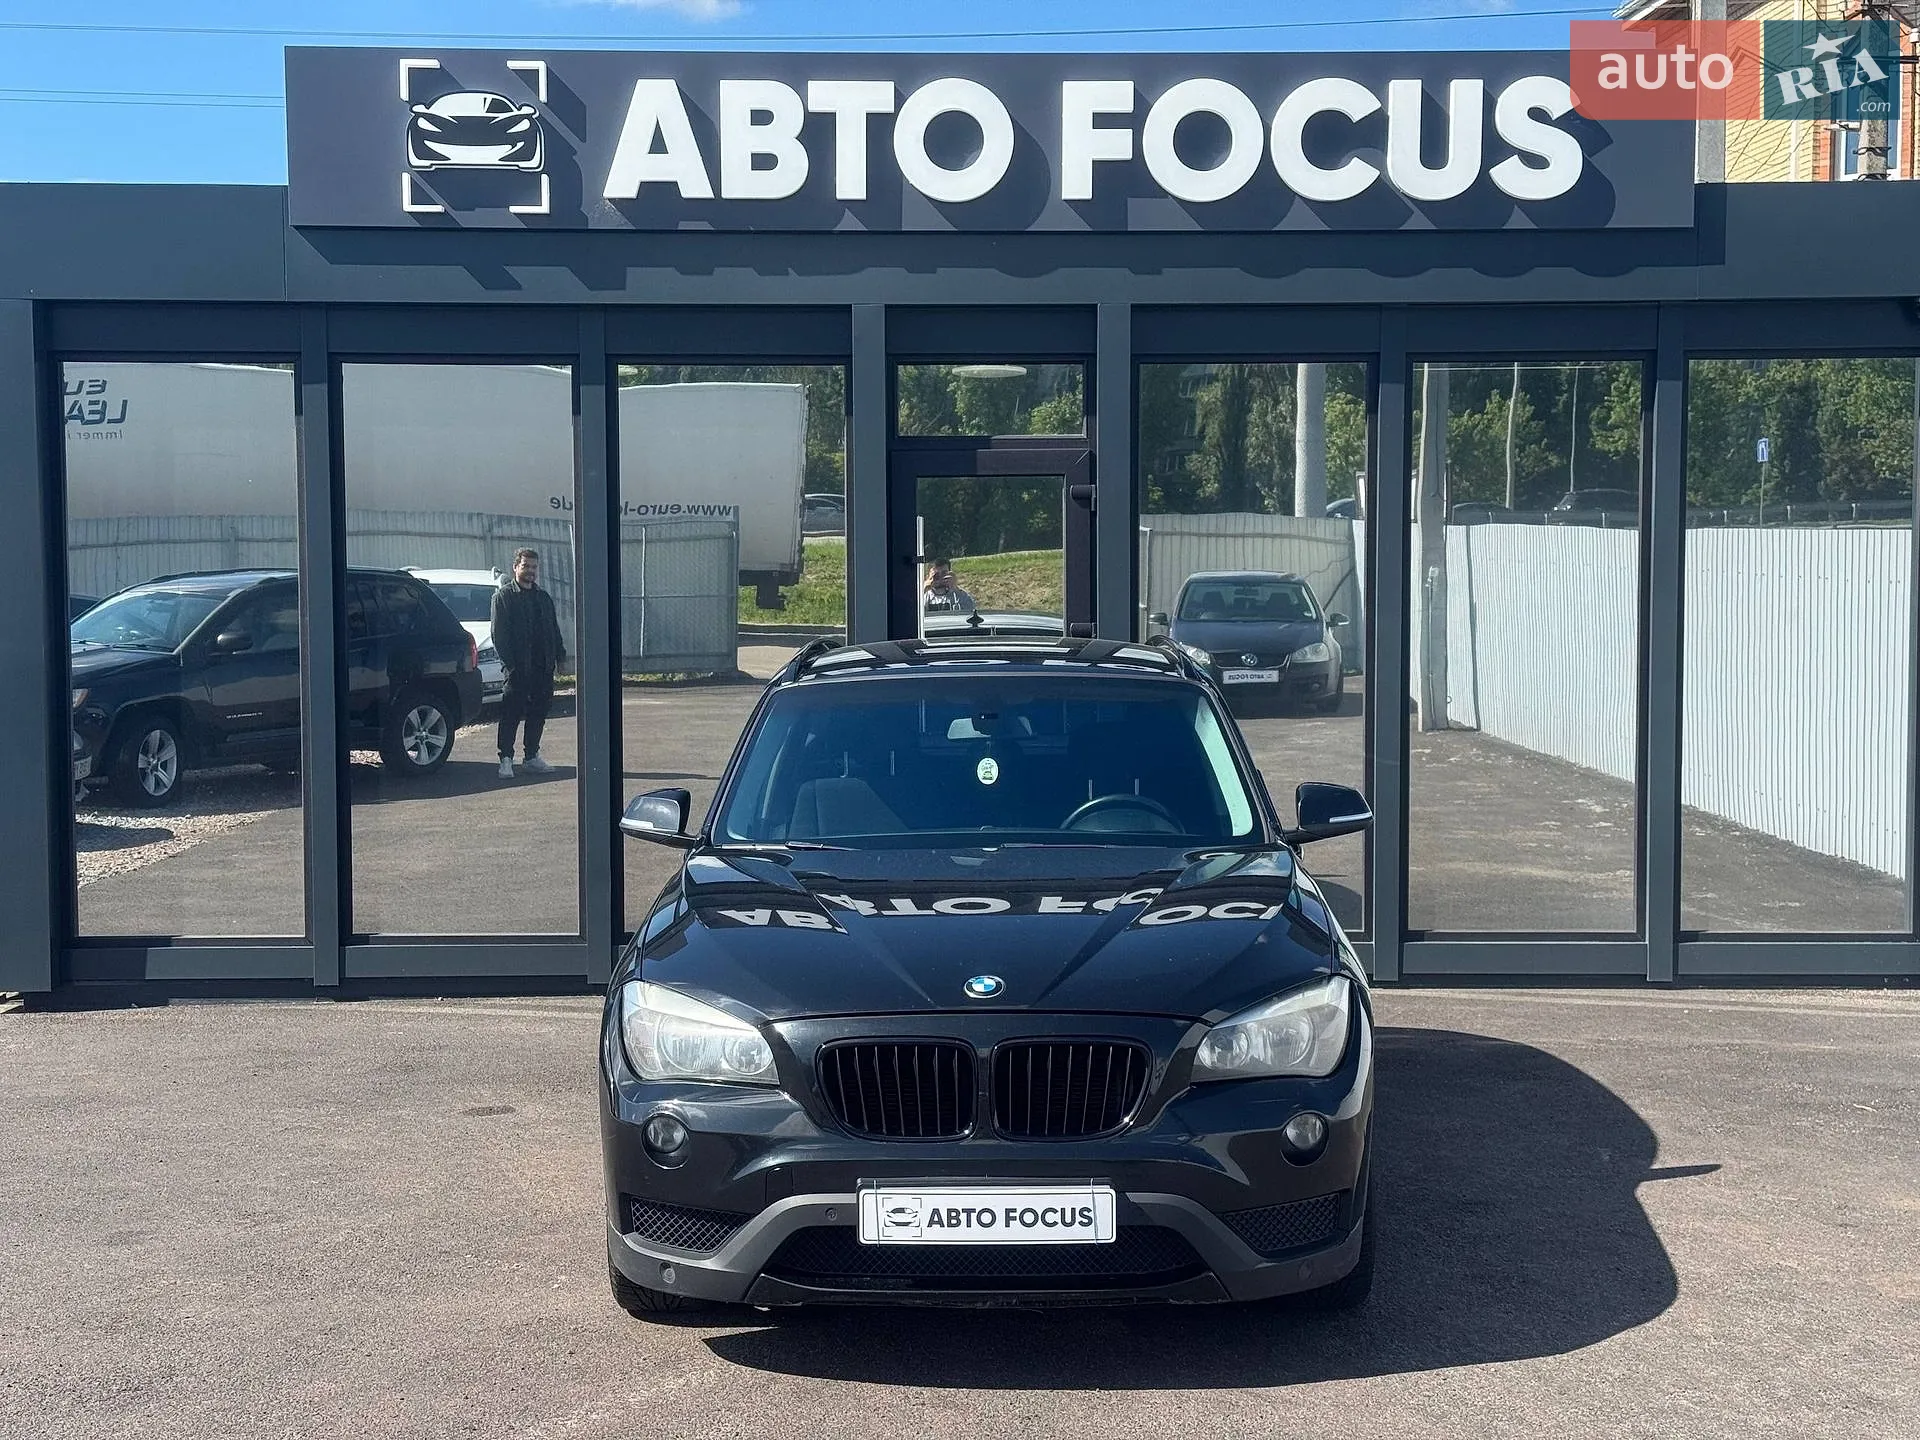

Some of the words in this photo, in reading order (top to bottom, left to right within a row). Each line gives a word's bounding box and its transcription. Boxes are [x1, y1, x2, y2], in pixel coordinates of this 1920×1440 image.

[602, 77, 1015, 203] АВТО
[1061, 76, 1585, 203] FOCUS
[926, 1207, 997, 1228] АВТО
[1004, 1206, 1093, 1228] FOCUS
